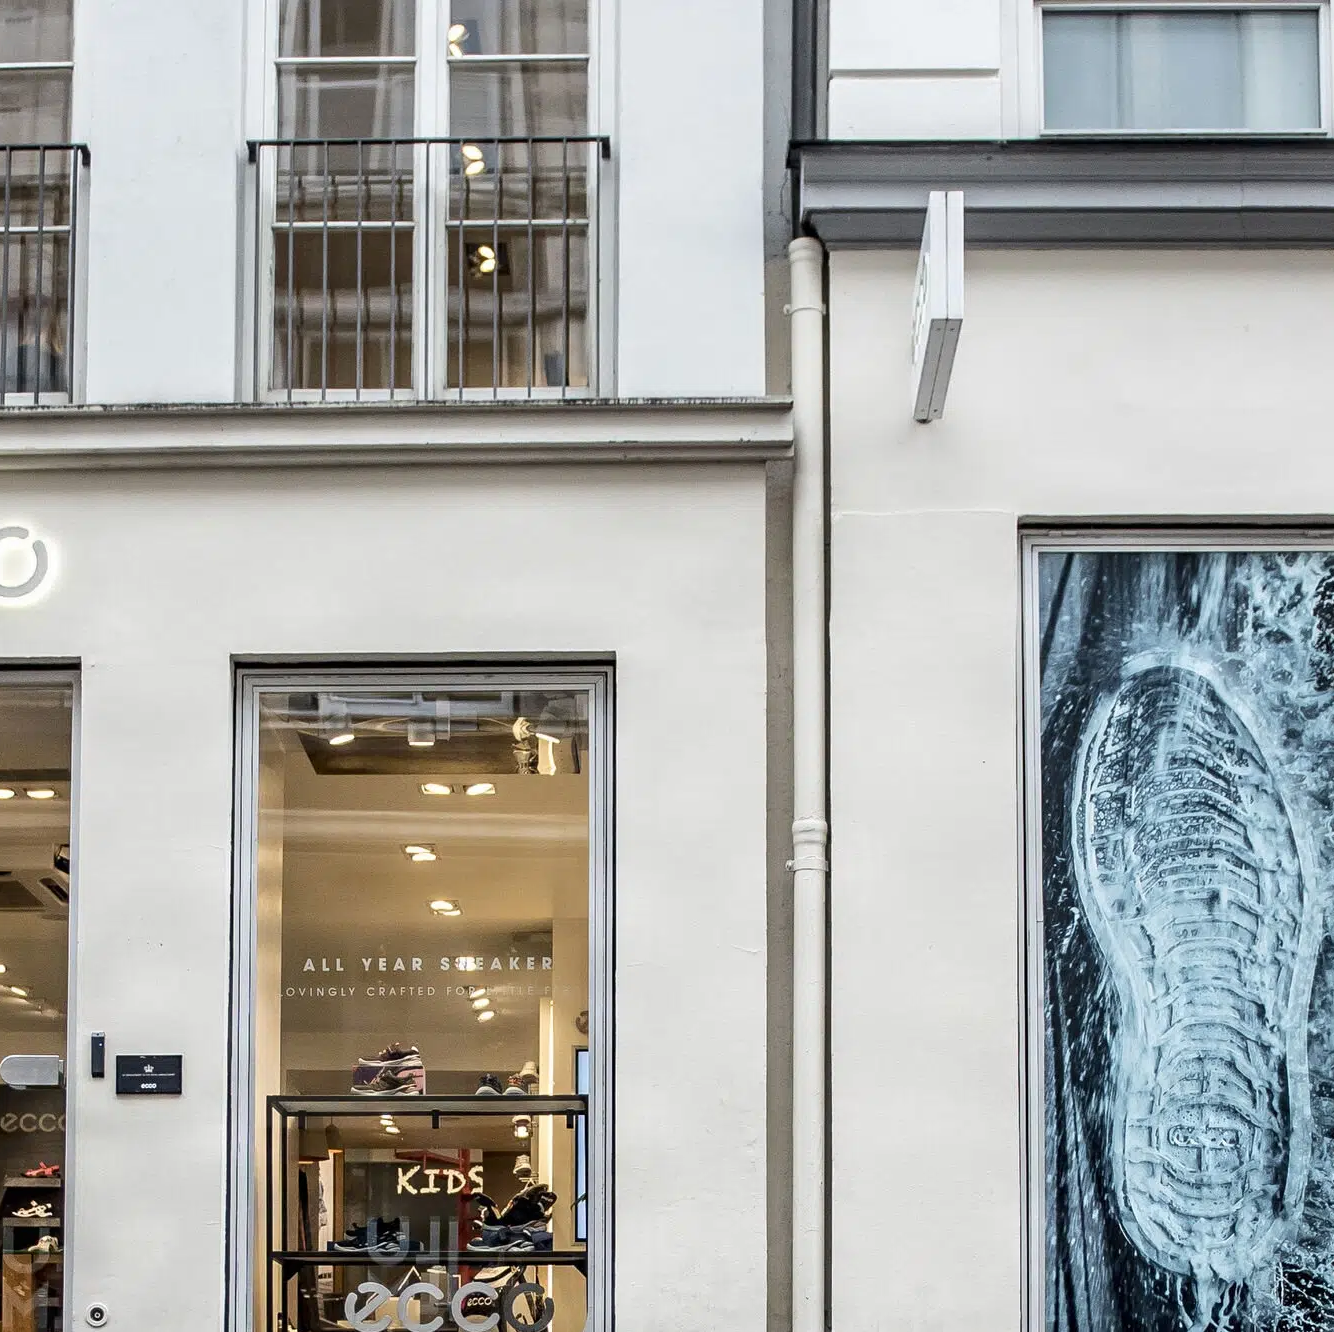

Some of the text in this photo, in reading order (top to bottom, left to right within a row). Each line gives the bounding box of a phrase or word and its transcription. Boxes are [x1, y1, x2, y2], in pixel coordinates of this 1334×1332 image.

[303, 958, 344, 972] ALL
[362, 957, 423, 972] YEAR
[279, 987, 356, 997] OVINGLY
[367, 986, 436, 997] CRAFTED
[446, 986, 475, 997] FOR
[396, 1165, 484, 1195] KIDS
[467, 1297, 493, 1308] ecco
